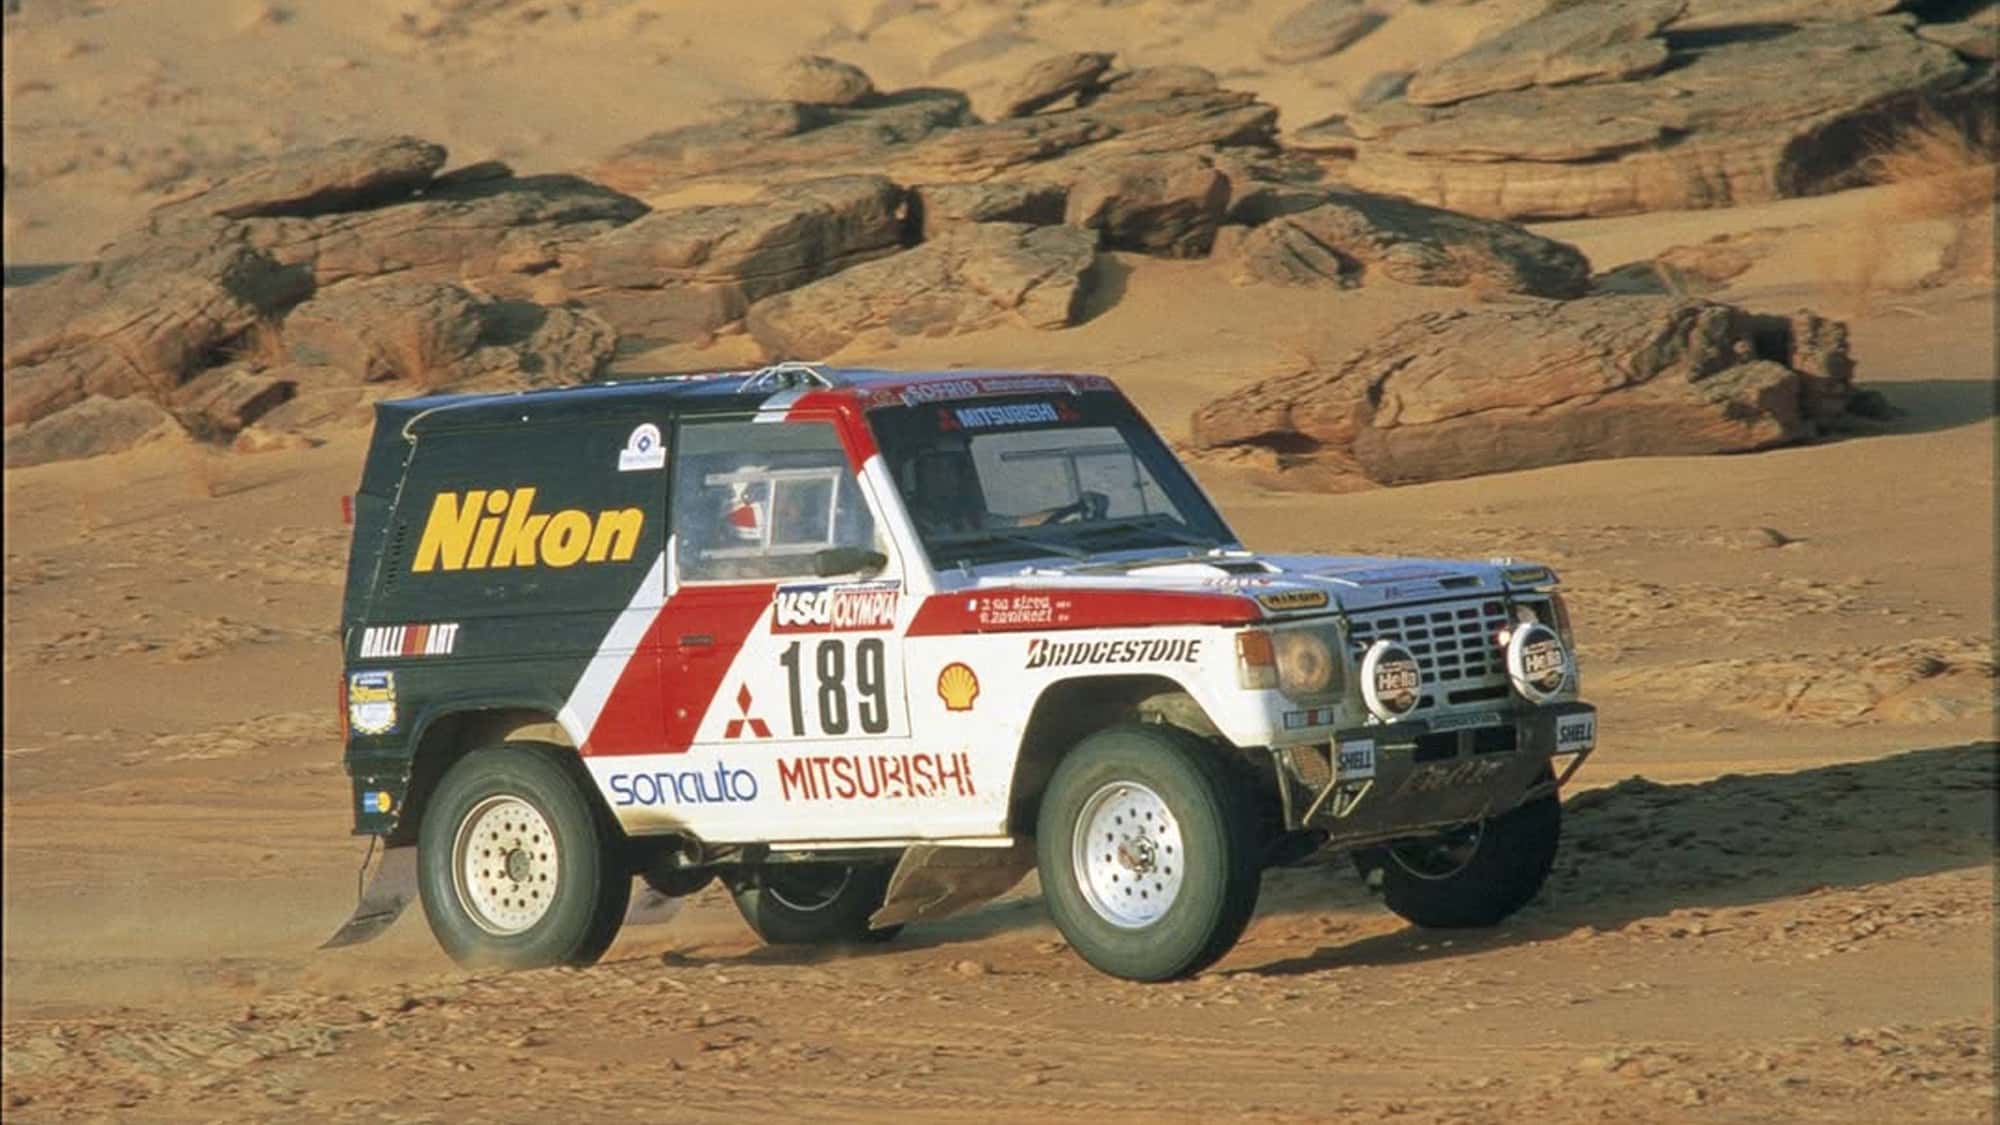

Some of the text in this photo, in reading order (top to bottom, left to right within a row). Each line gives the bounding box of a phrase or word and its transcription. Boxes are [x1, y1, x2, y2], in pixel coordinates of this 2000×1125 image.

[955, 403, 1059, 428] MITSUBISHI
[411, 487, 645, 573] Nikon
[834, 591, 897, 626] OLYMPIA
[1025, 639, 1202, 669] BRIDGESTONE
[780, 637, 889, 737] 189
[1379, 671, 1417, 690] Hella
[1558, 722, 1595, 745] SHELL
[1338, 747, 1373, 771] SHELL
[609, 760, 759, 807] sonauto
[776, 752, 976, 801] MITSUBISHI
